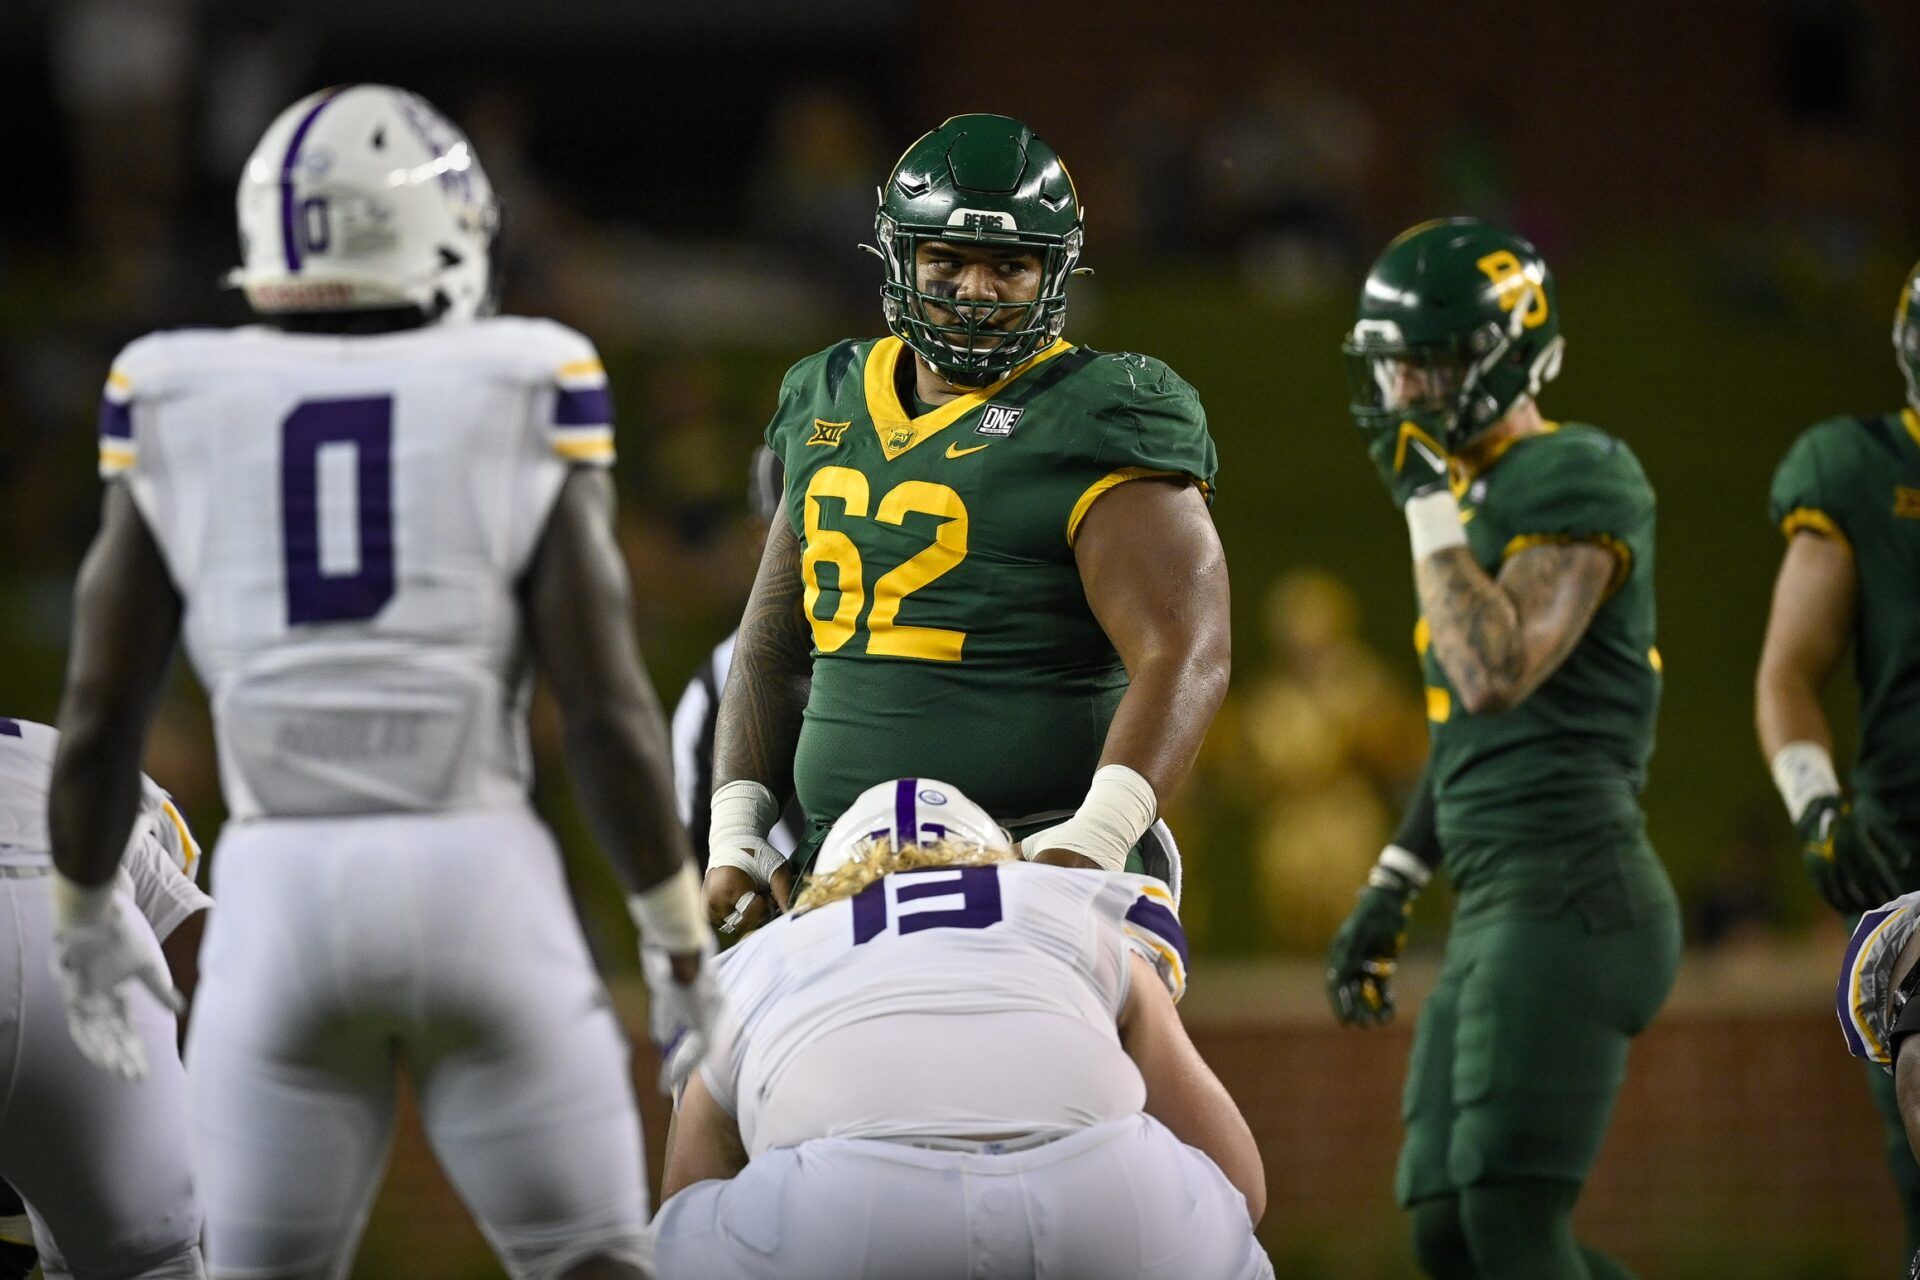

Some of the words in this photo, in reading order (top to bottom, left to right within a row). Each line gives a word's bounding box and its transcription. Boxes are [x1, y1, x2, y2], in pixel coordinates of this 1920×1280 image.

[303, 198, 329, 253] 0
[983, 407, 1020, 429] ONE
[282, 392, 396, 624] 0
[803, 466, 968, 662] 62
